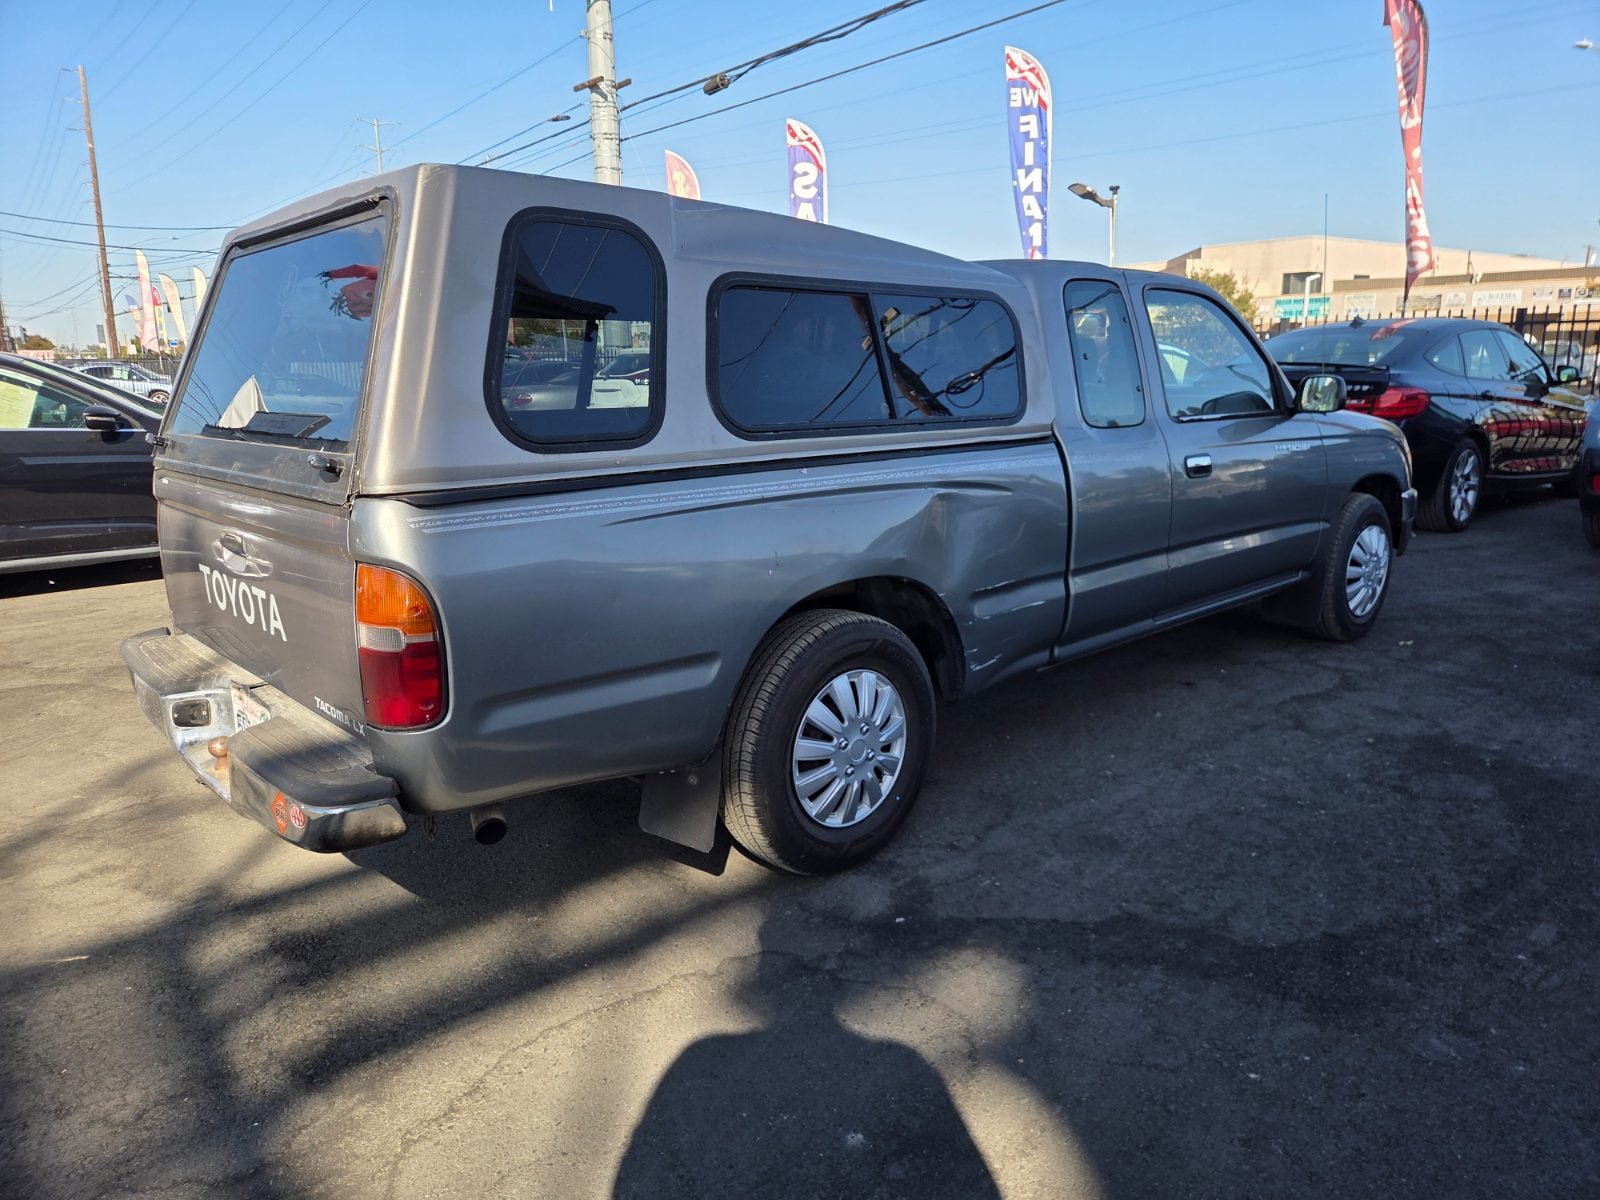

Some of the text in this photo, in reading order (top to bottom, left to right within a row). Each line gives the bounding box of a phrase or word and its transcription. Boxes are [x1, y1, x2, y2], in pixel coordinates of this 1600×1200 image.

[199, 563, 287, 642] TOYOTA
[314, 695, 366, 736] TACOMA LX
